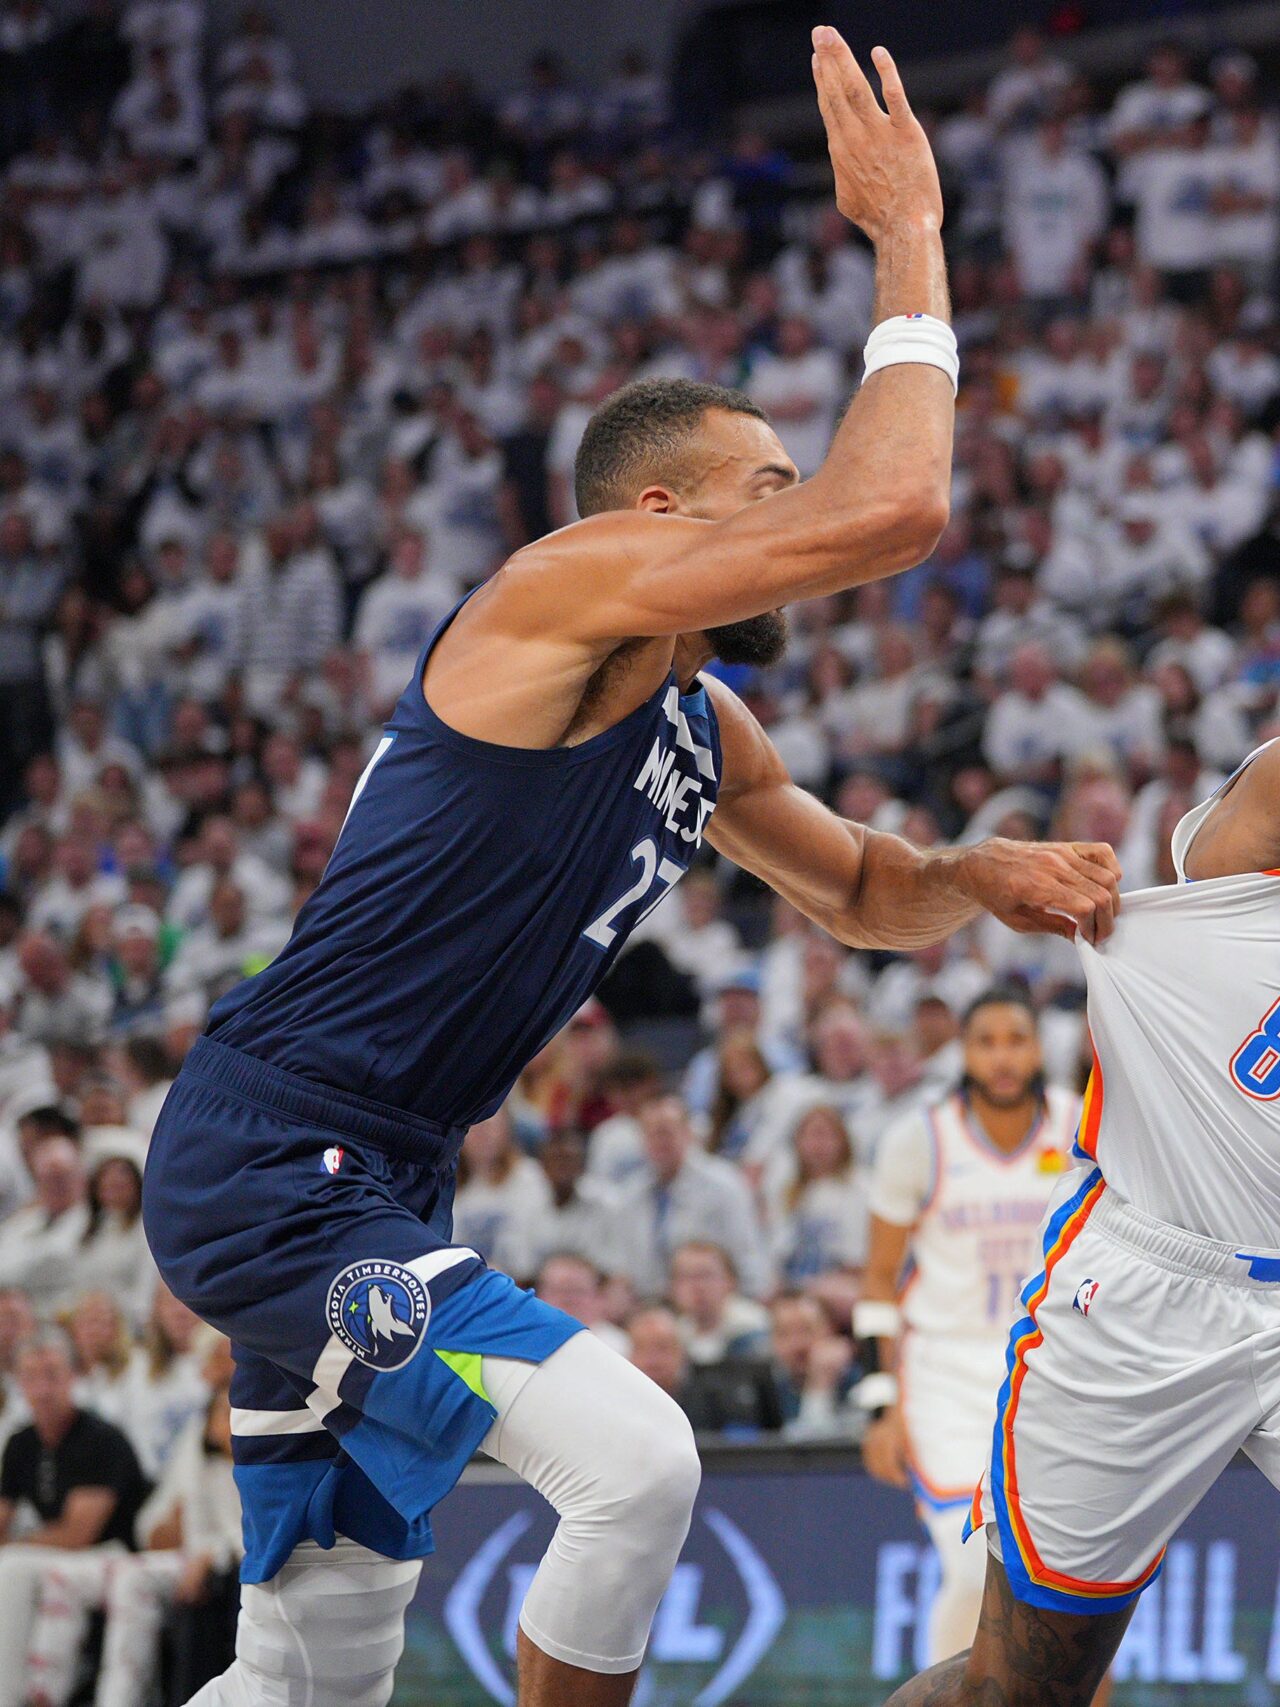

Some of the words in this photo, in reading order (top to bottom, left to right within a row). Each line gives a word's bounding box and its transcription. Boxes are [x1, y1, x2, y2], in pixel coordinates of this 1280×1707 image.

[582, 833, 689, 951] 27
[330, 1284, 366, 1358] MINNESOTA
[346, 1264, 425, 1320] TIMBERWOLVES
[872, 1540, 1246, 1685] FALL
